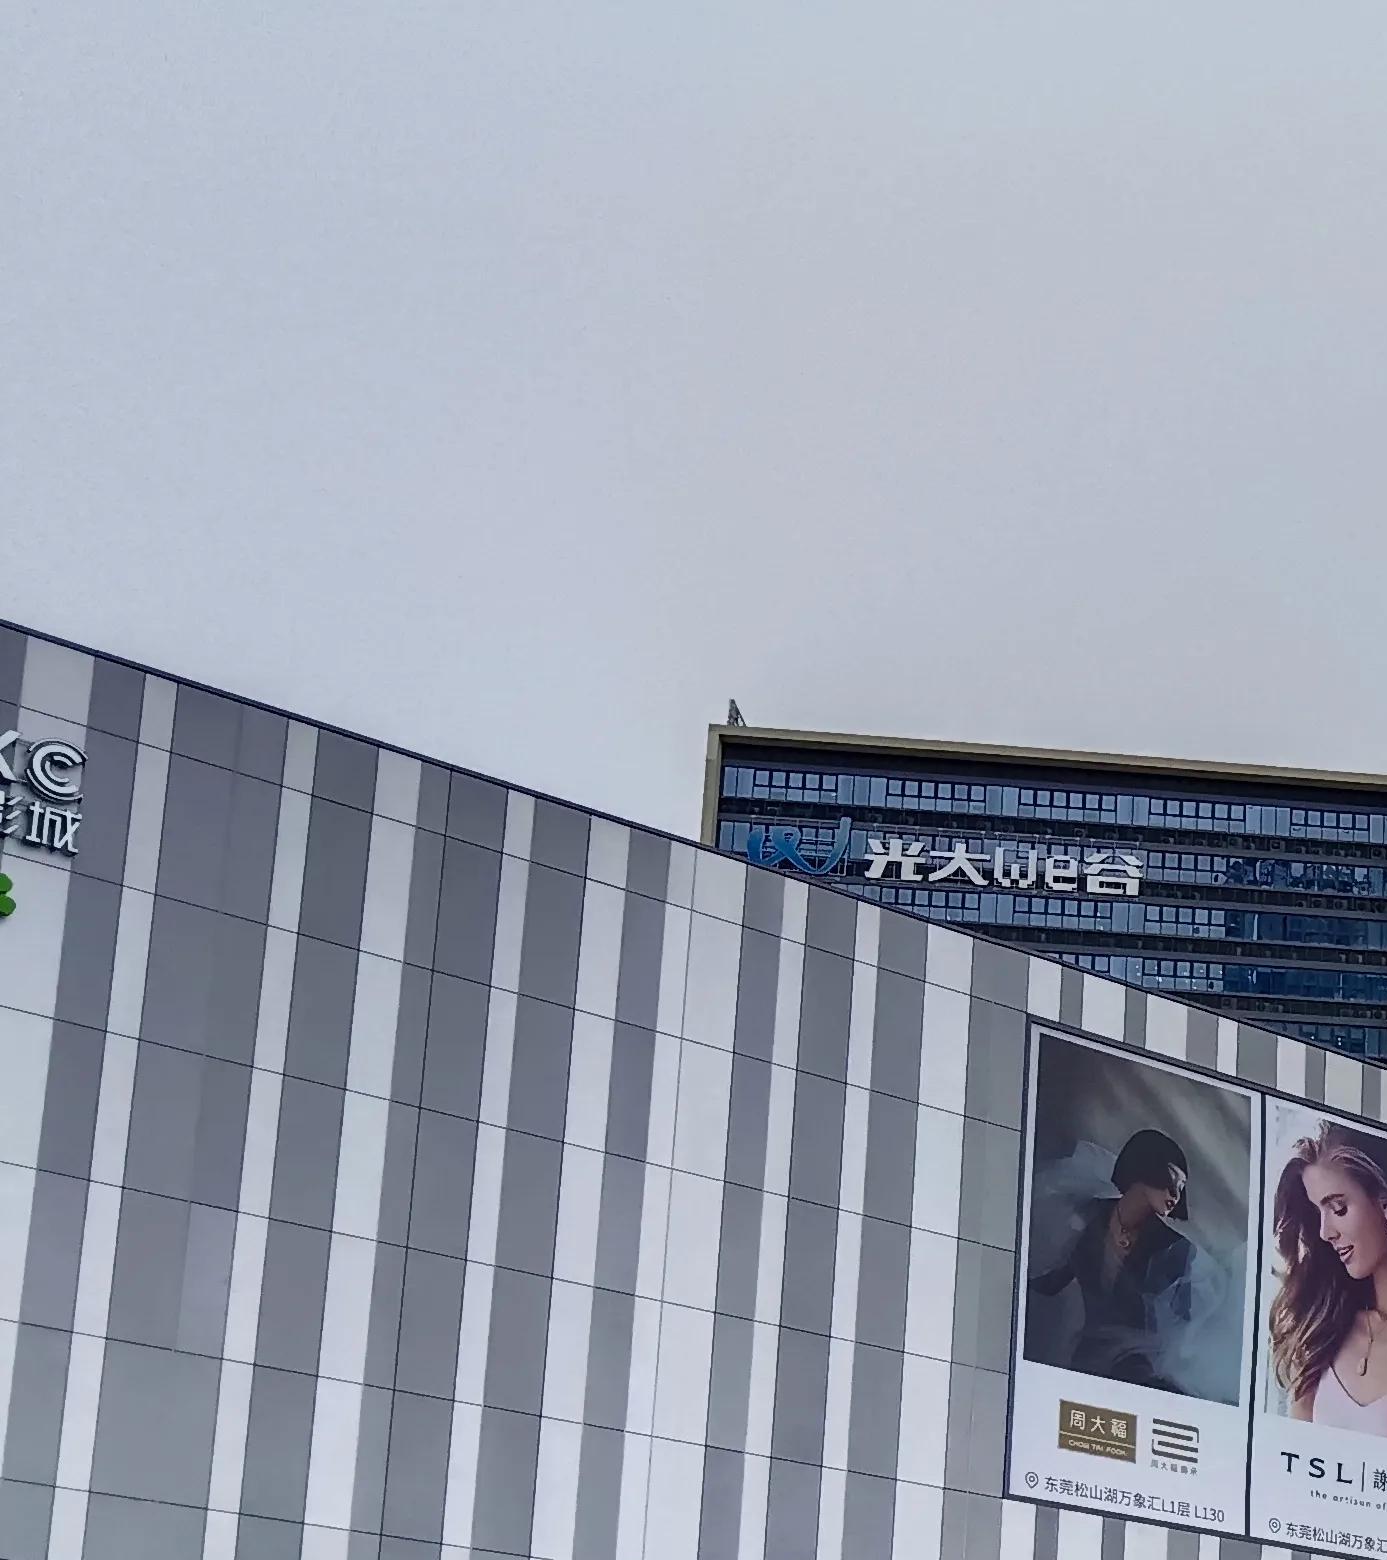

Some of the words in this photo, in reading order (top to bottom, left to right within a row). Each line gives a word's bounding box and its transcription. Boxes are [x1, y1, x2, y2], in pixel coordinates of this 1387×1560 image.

[1070, 1409, 1127, 1438] 周大福
[1281, 1451, 1353, 1484] TSL
[1310, 1489, 1327, 1500] the
[1376, 1502, 1387, 1511] of
[1194, 1504, 1225, 1523] L130
